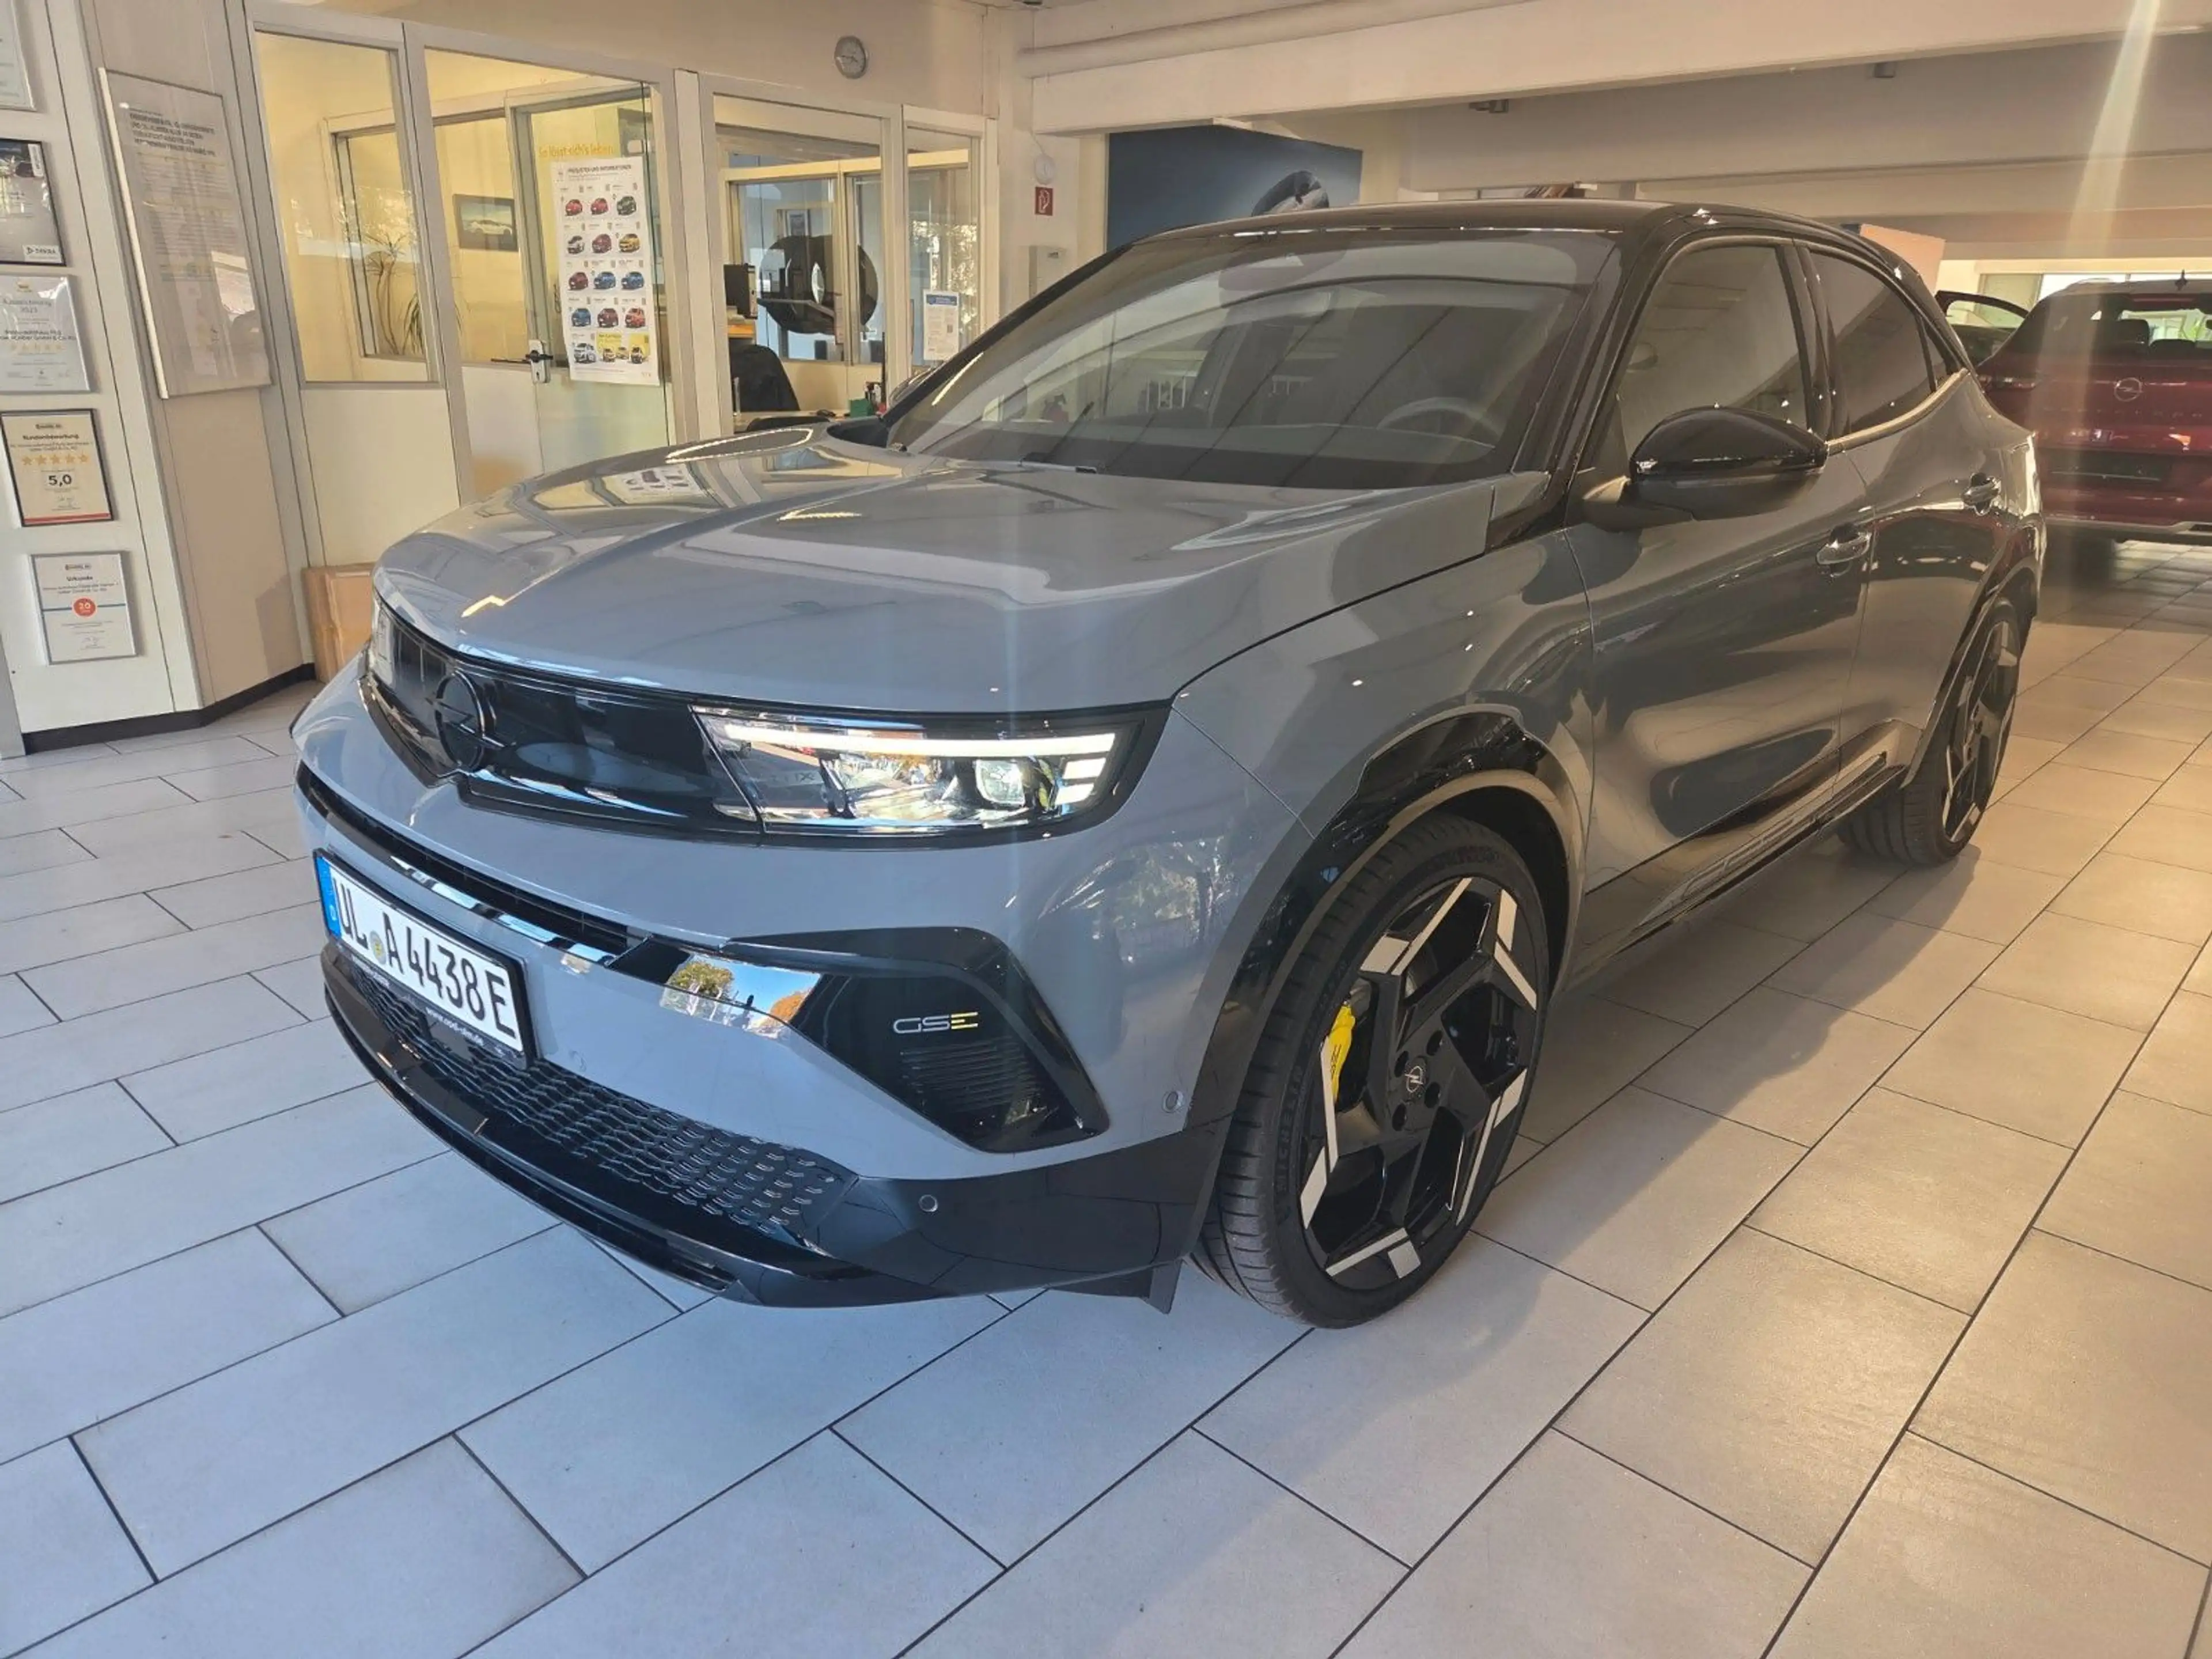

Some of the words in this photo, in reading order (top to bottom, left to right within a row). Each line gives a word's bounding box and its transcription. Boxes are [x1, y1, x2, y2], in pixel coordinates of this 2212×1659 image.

[48, 474, 72, 487] 5,0
[334, 877, 369, 949] UL
[893, 1012, 978, 1034] GSE
